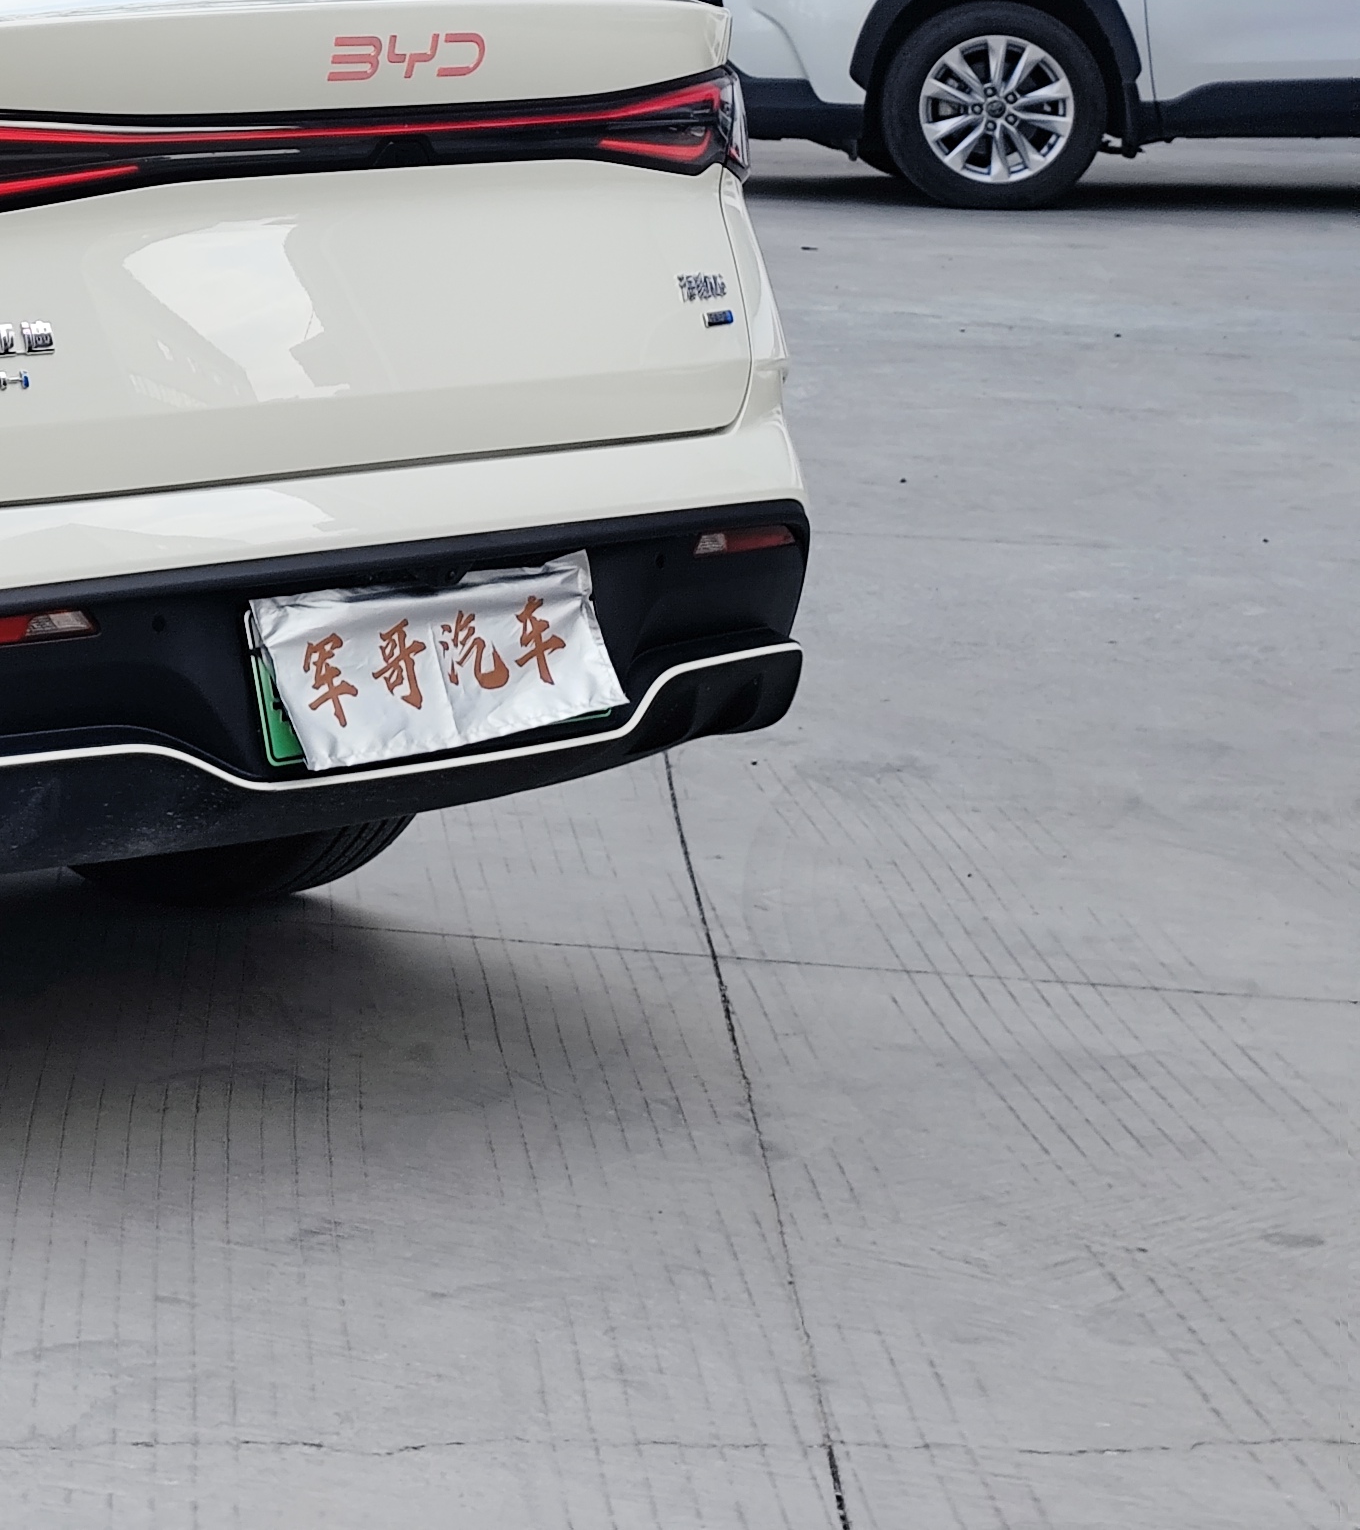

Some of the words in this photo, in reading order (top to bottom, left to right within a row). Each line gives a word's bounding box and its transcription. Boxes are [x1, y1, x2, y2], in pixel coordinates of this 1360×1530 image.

[327, 32, 486, 82] BYD
[303, 595, 566, 728] 军哥汽车
